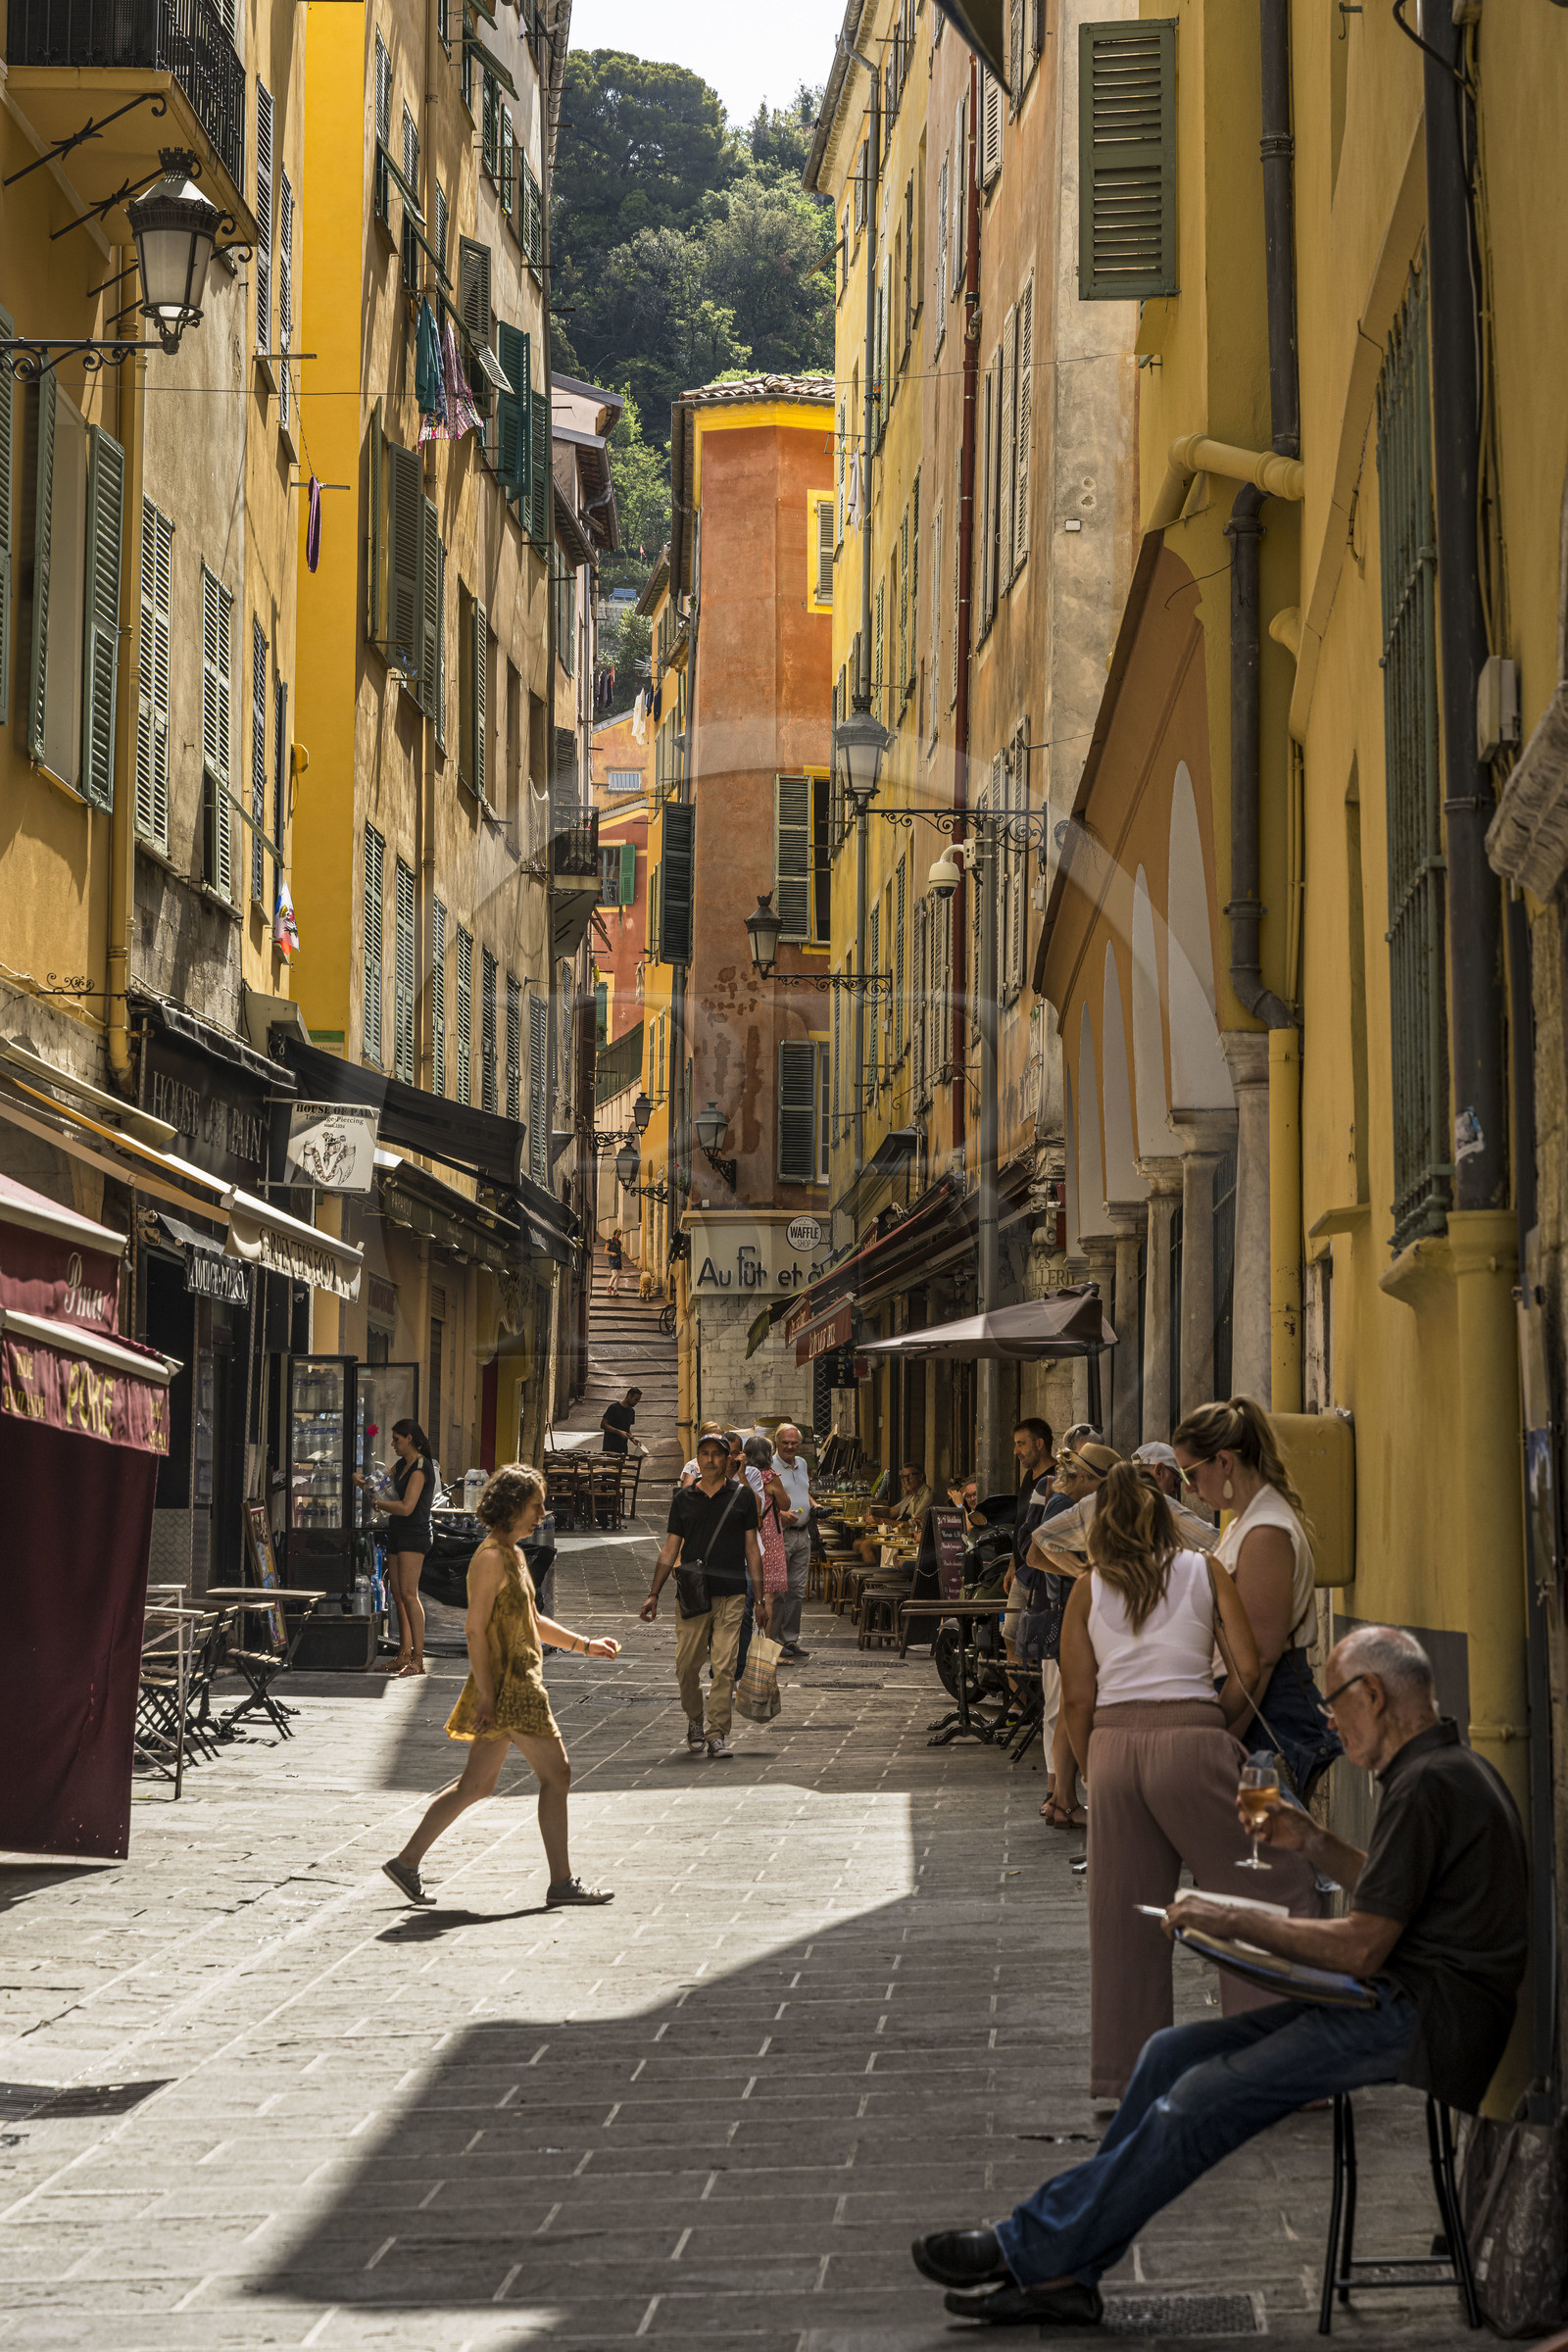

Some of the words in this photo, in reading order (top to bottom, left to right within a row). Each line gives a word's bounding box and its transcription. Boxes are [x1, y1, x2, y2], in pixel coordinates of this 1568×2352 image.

[154, 1071, 200, 1138] HOUSE
[296, 1103, 330, 1114] HOUSE
[333, 1105, 348, 1115] OF
[790, 1226, 819, 1240] WAFFLE
[796, 1239, 812, 1249] SHOP
[697, 1256, 732, 1287] Au
[777, 1262, 803, 1287] et
[66, 1362, 114, 1440] POKE
